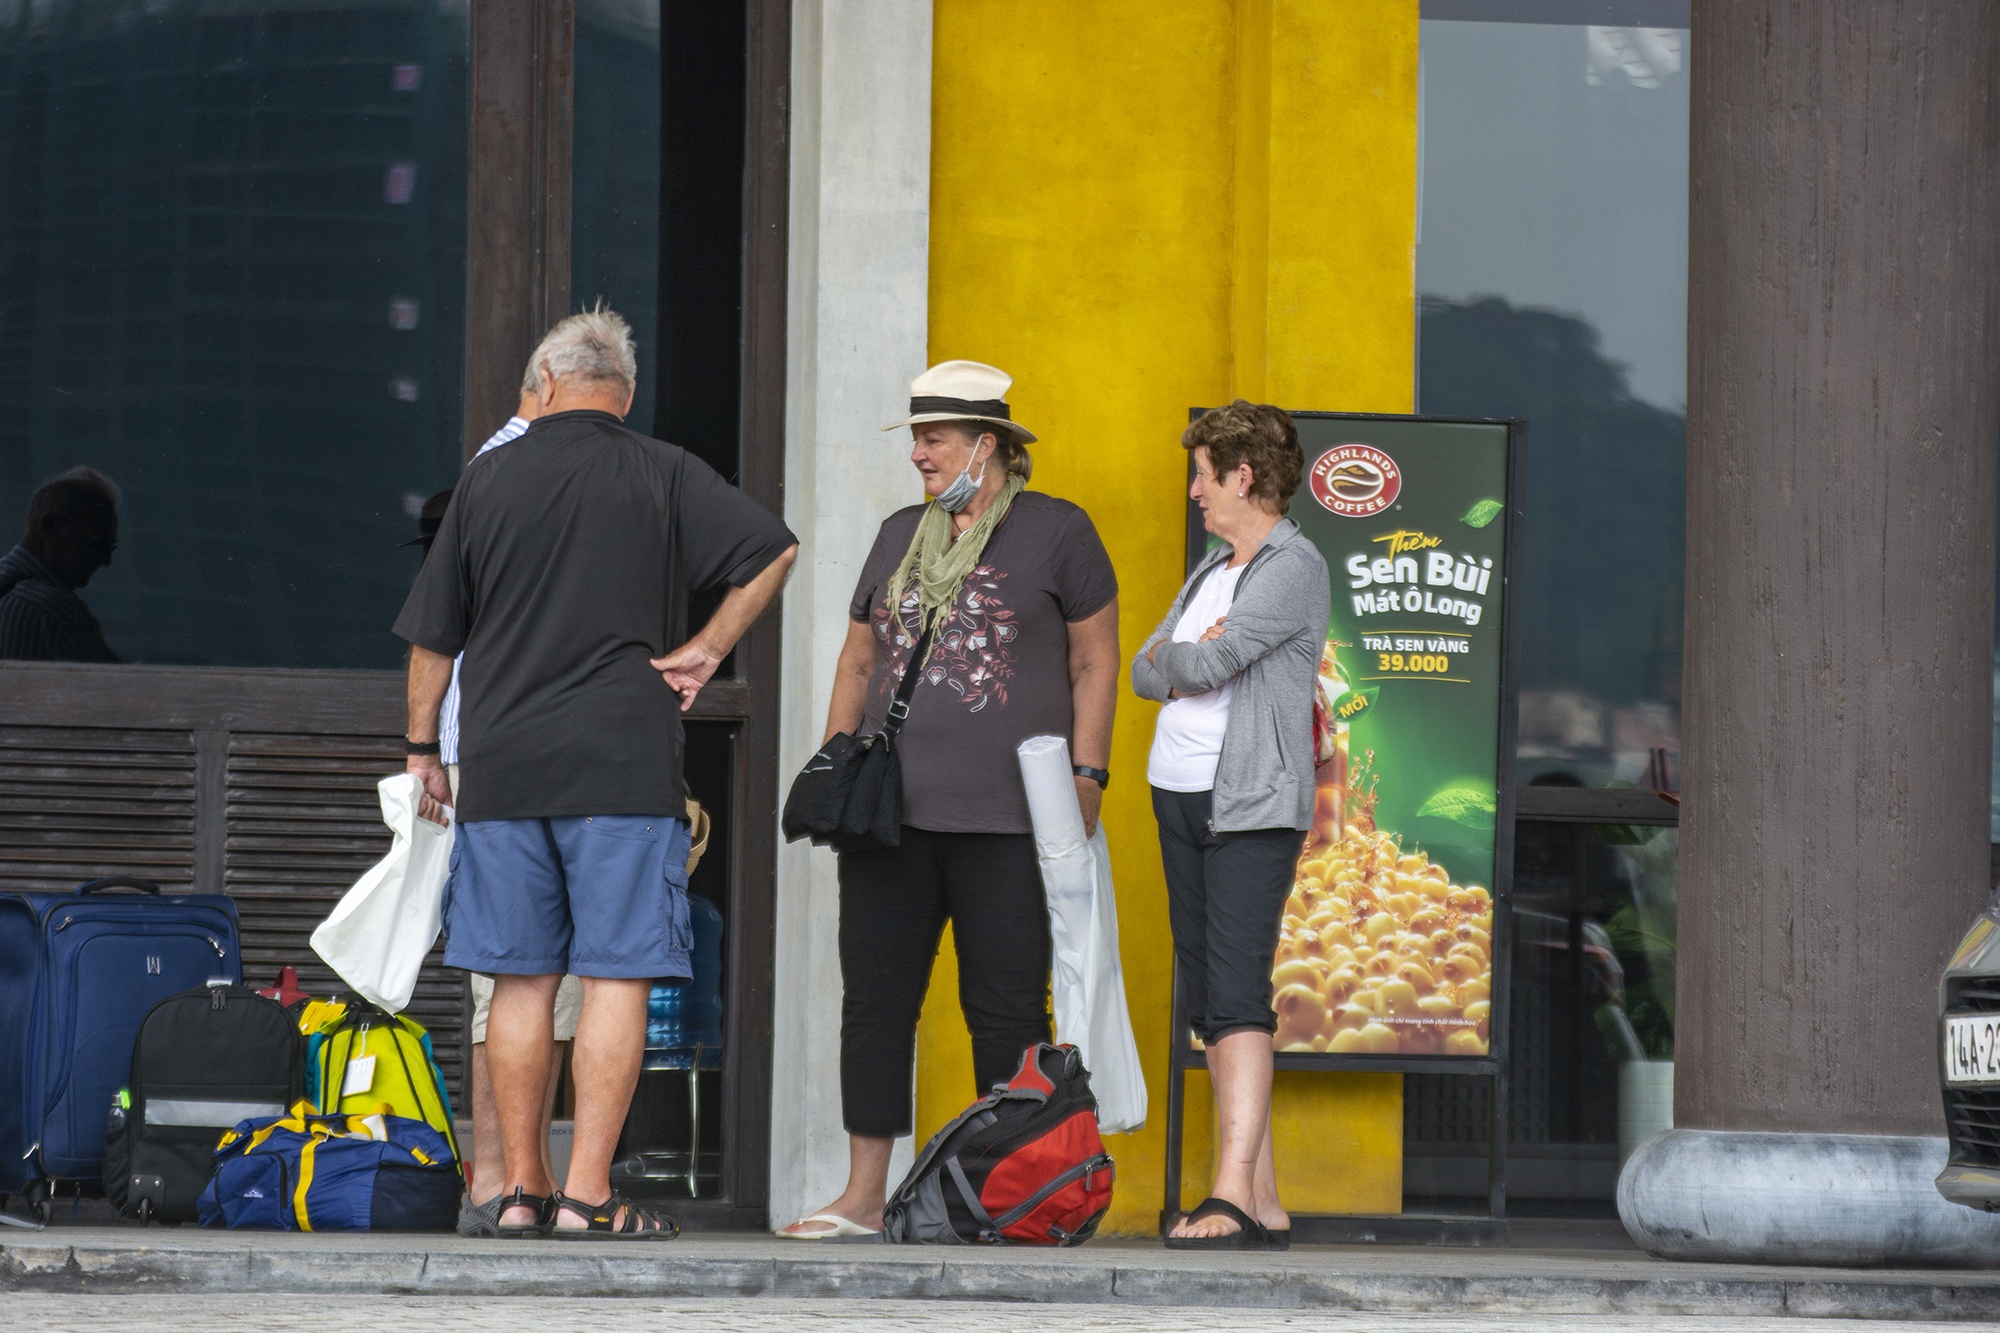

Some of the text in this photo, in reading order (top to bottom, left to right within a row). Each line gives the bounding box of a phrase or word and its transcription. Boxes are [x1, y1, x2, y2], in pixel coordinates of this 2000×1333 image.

[1315, 449, 1397, 479] HIGHLANDS
[1324, 495, 1386, 513] COFFEE
[1373, 530, 1443, 564] Thêm
[1347, 552, 1493, 595] Sen Bùi
[1353, 589, 1401, 617] Mát
[1363, 635, 1470, 654] TRÀ SEN VÀNG
[1378, 654, 1449, 673] 39.000
[1339, 693, 1370, 719] MỚI
